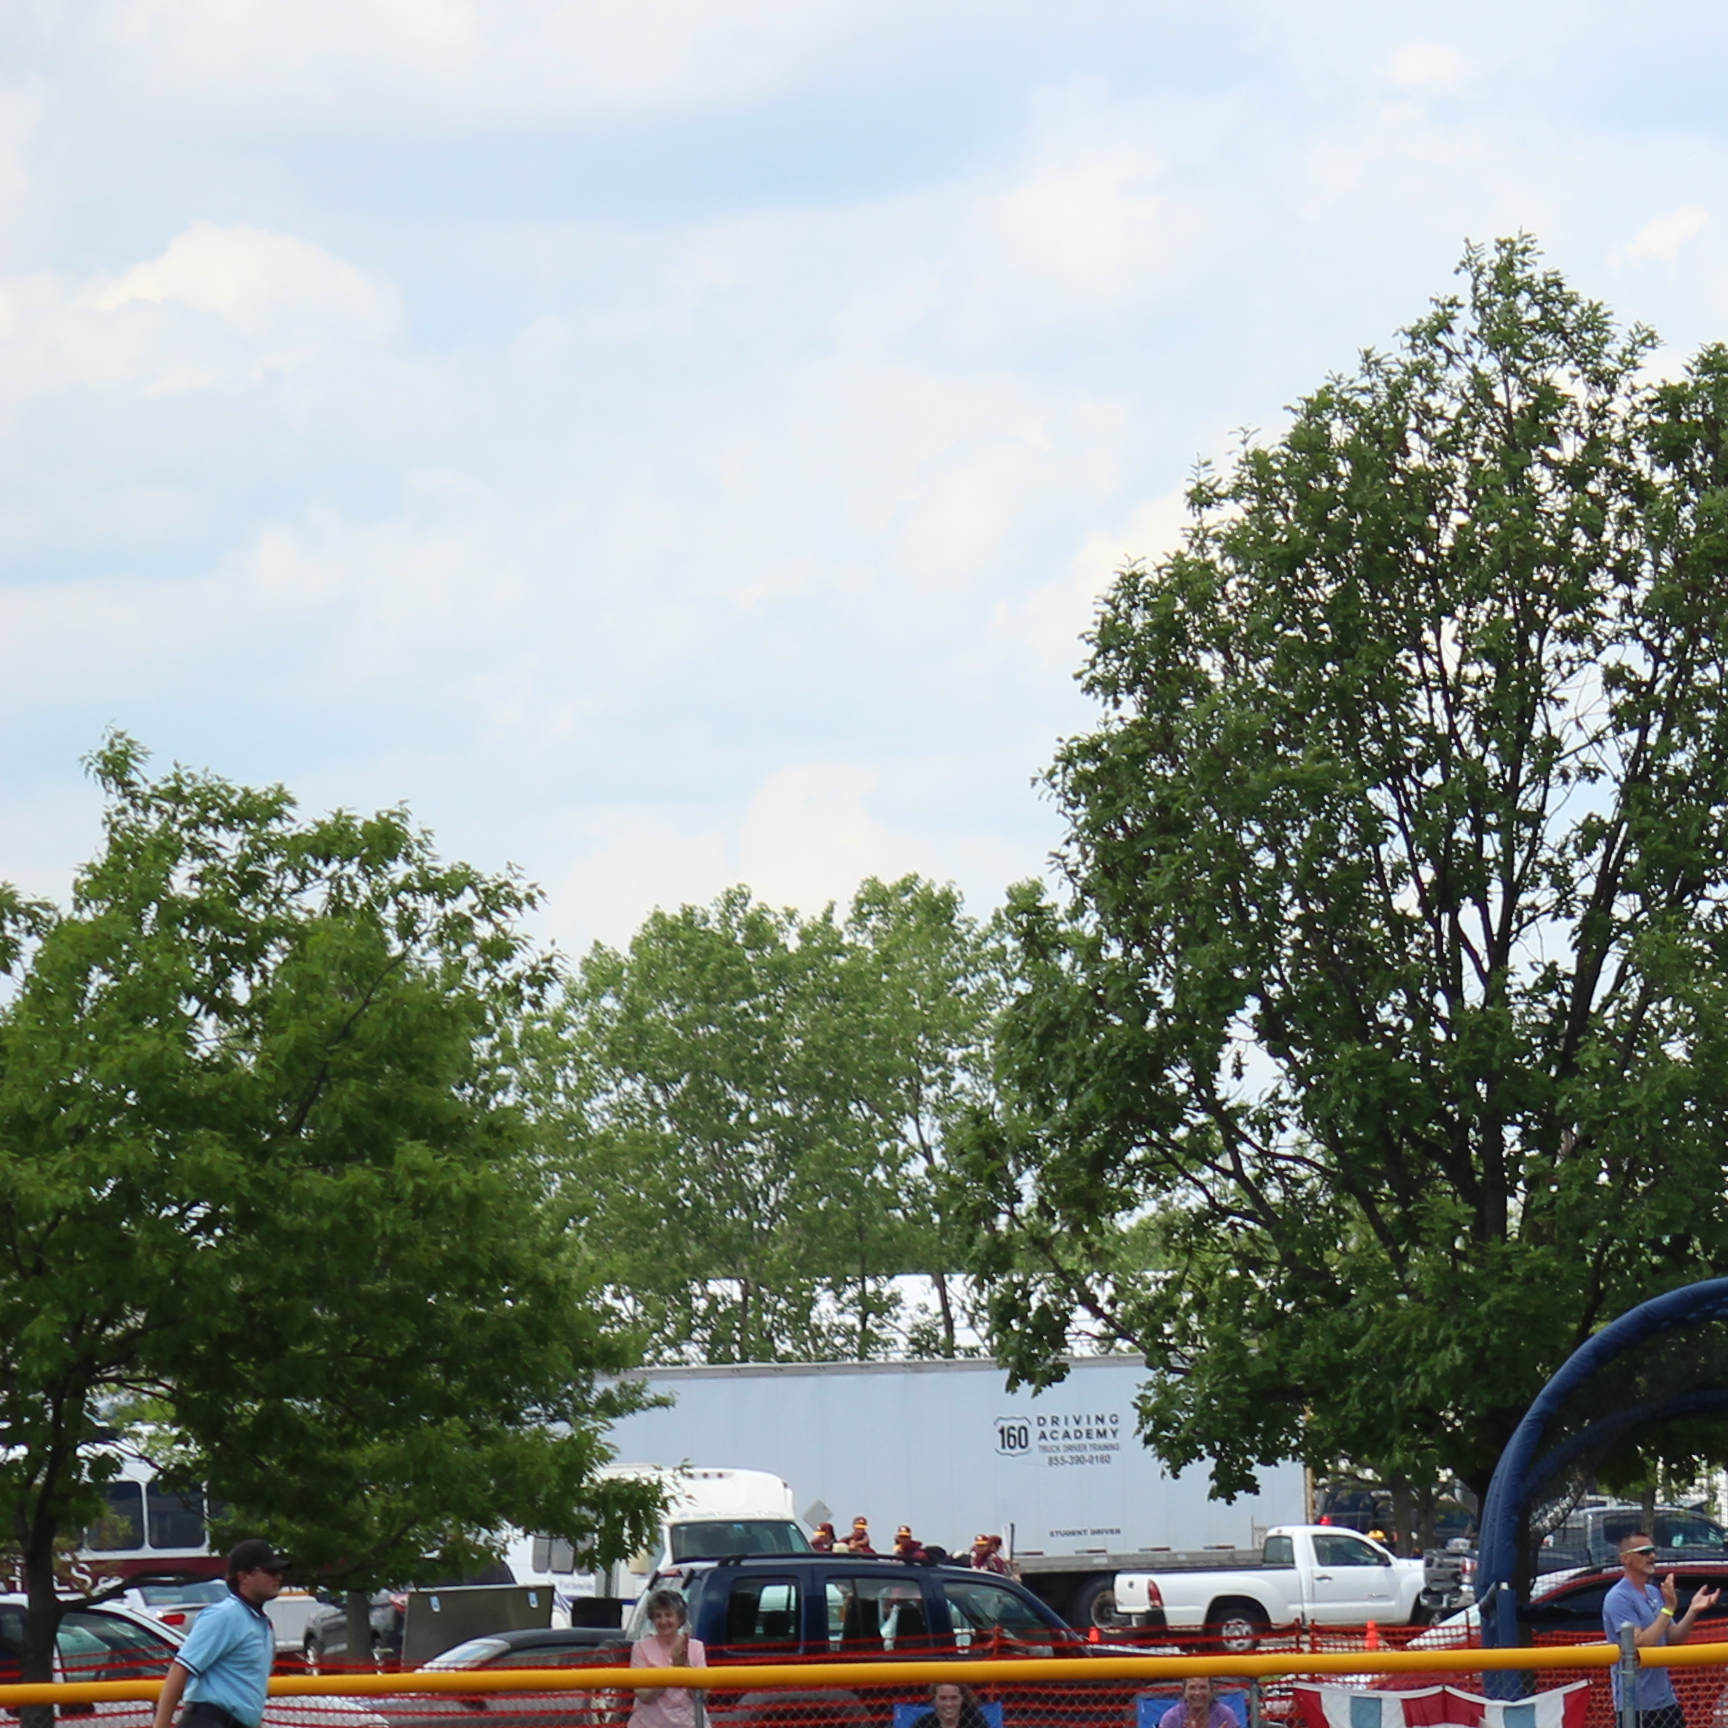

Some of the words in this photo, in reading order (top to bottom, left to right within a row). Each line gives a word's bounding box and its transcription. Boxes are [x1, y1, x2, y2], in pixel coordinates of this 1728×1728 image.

[1036, 1413, 1120, 1427] DRIVING
[997, 1425, 1029, 1450] 160
[1038, 1428, 1120, 1441] ACADEMY
[1038, 1444, 1061, 1453] TRUCK
[1062, 1443, 1087, 1452] DRIVER
[1089, 1442, 1120, 1451] TRAINING
[1049, 1529, 1088, 1537] STUDENT
